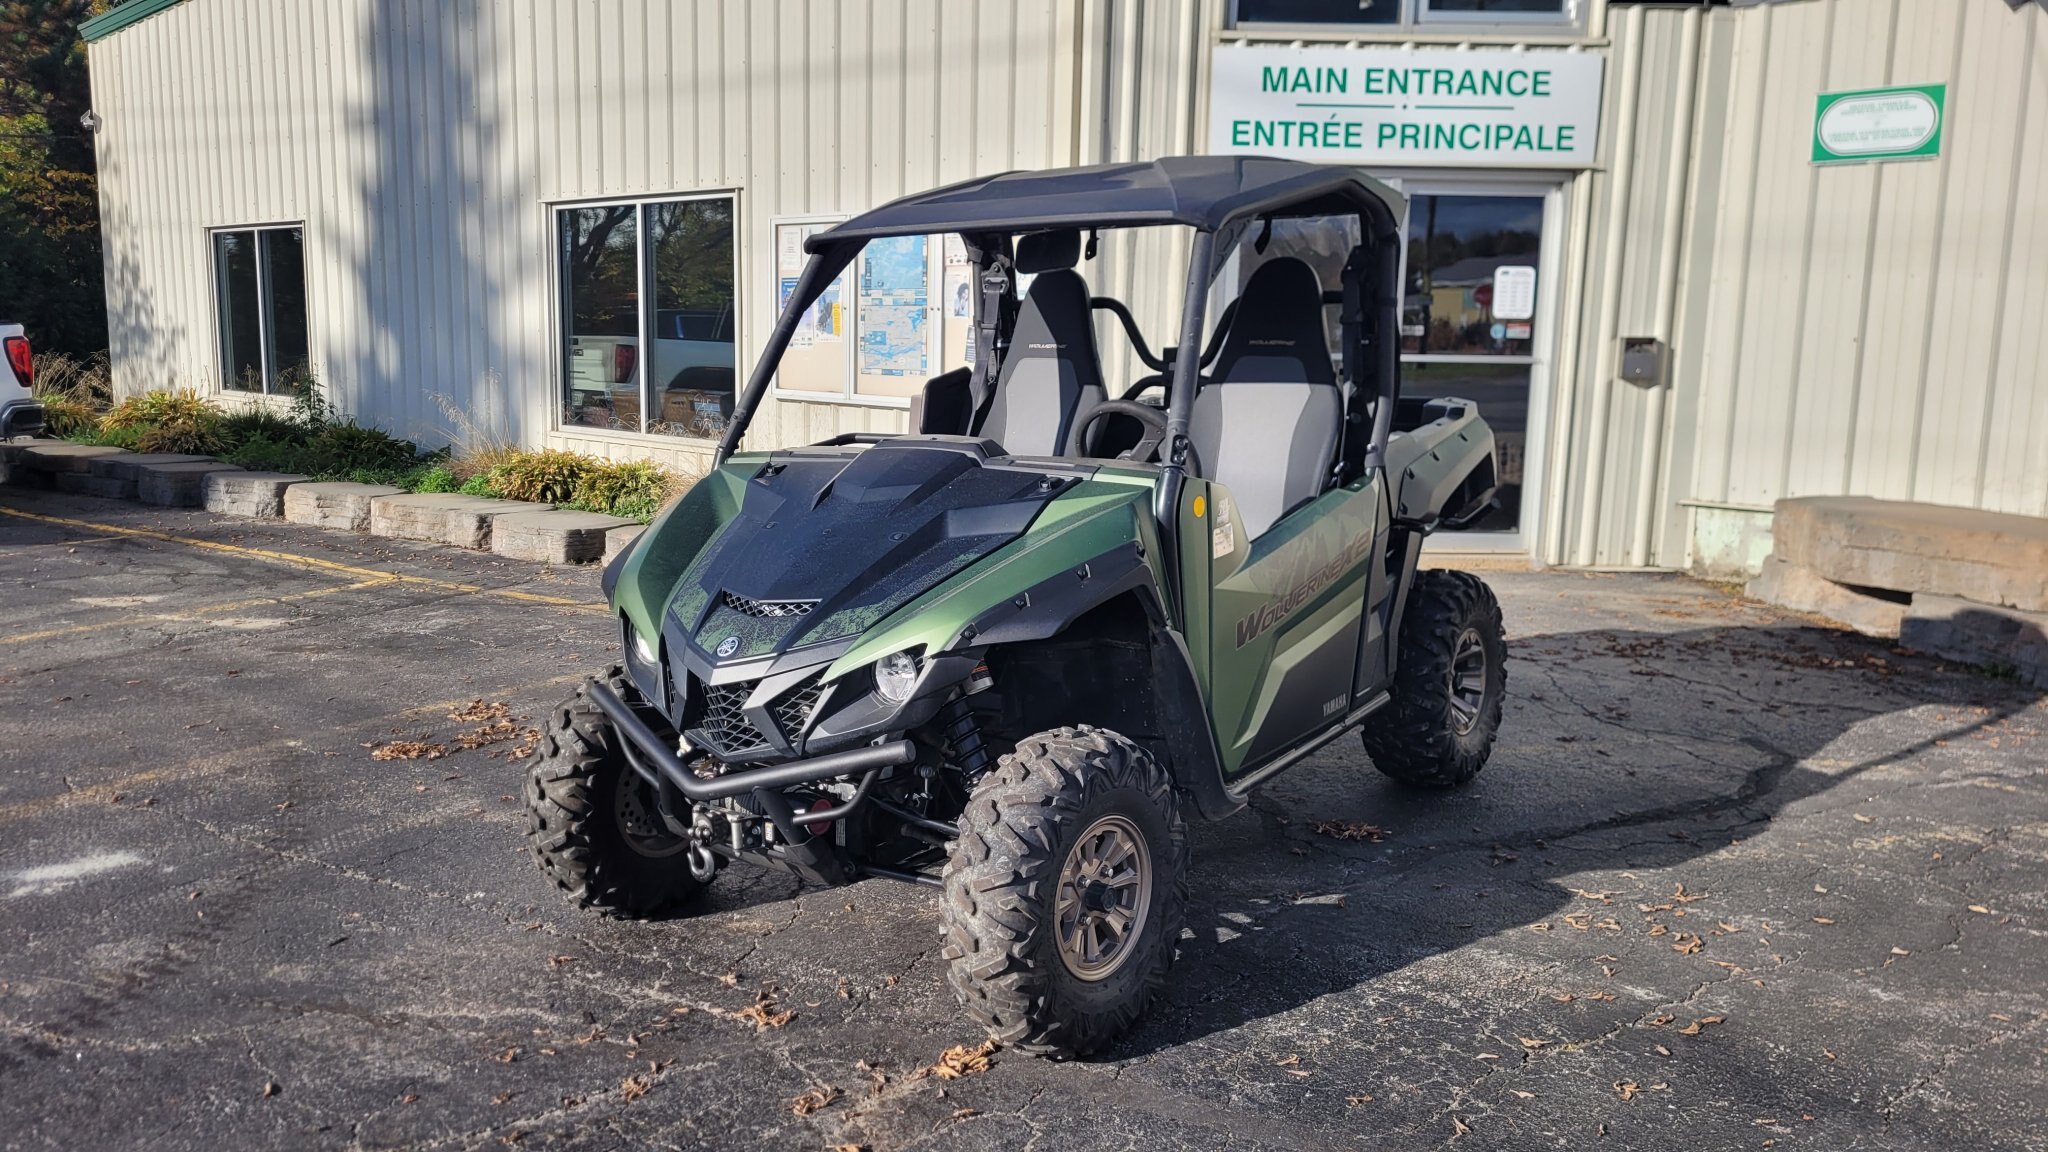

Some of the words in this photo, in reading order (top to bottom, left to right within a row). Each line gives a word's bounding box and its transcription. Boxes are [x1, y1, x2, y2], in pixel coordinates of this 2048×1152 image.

[1261, 66, 1348, 95] MAIN
[1364, 67, 1552, 97] ENTRANCE
[1231, 114, 1363, 149] ENTRÉE
[1377, 122, 1575, 152] PRINCIPALE
[1322, 693, 1347, 717] YAMAHA
